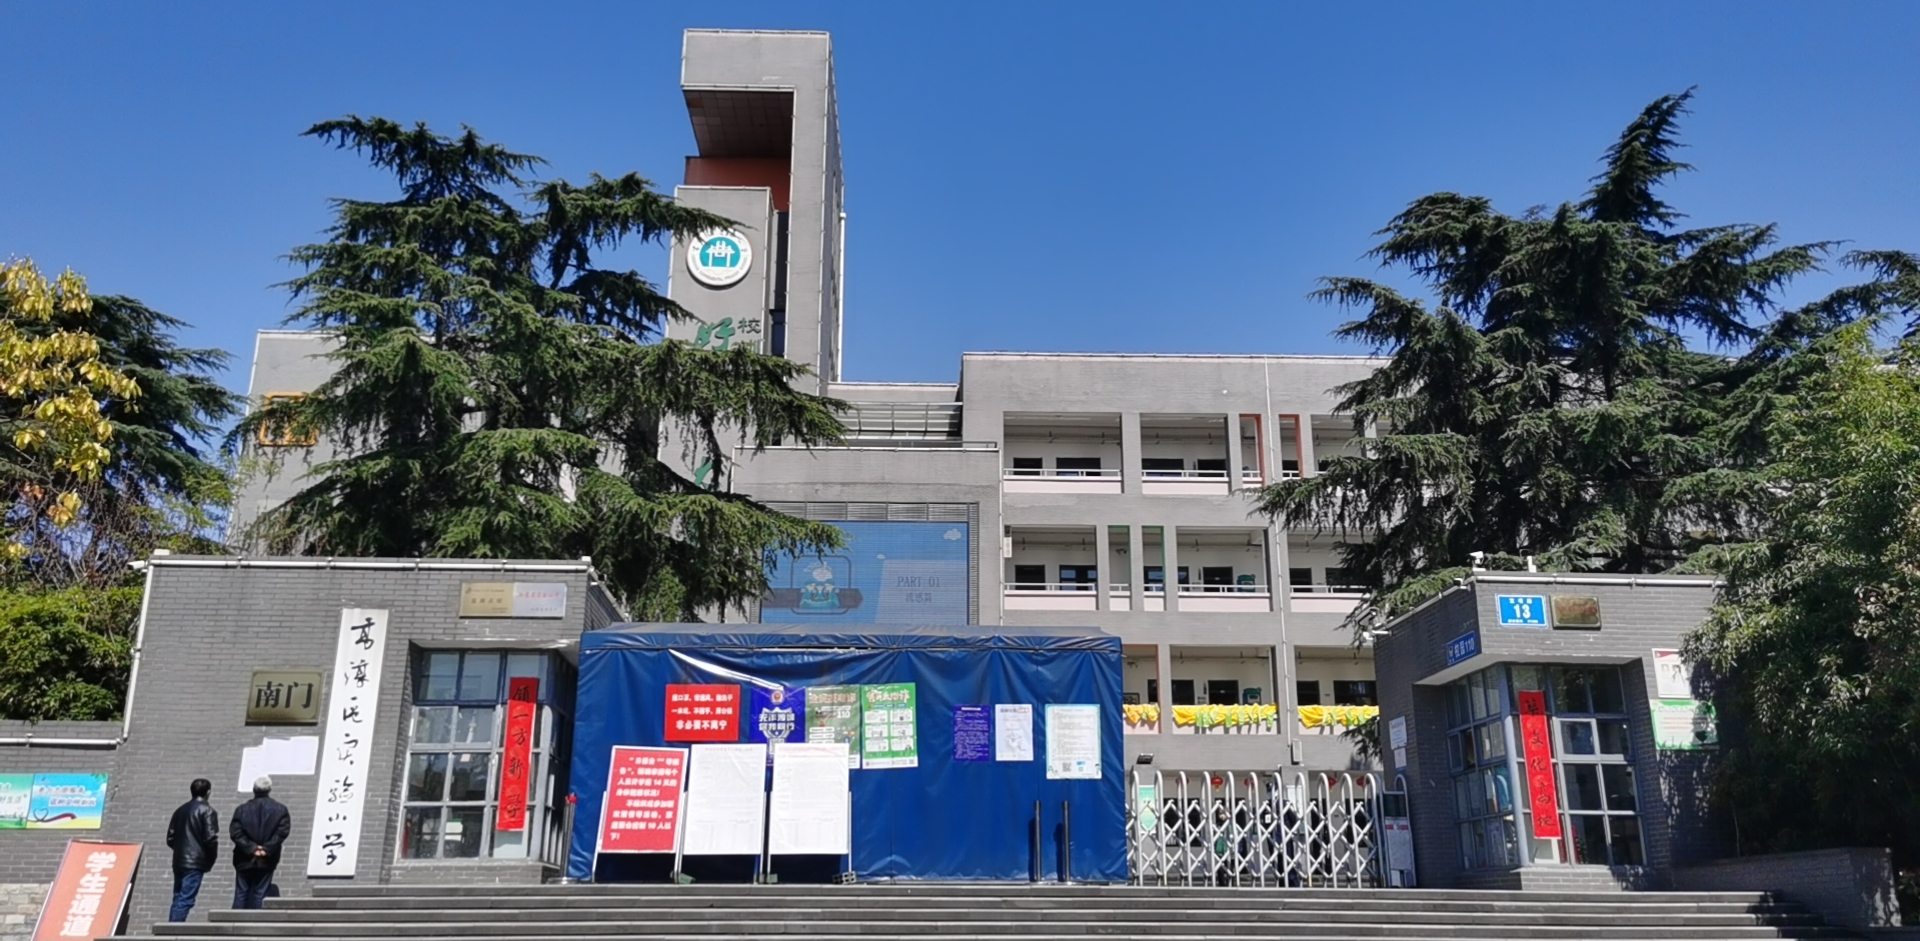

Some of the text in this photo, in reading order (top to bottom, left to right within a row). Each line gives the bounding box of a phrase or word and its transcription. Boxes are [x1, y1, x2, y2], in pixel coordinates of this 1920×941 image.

[896, 576, 940, 587] PART 01
[1514, 604, 1531, 618] 13
[255, 681, 313, 709] 南门
[322, 617, 375, 865] 高淳区实验小学
[60, 851, 117, 937] 学生通道
